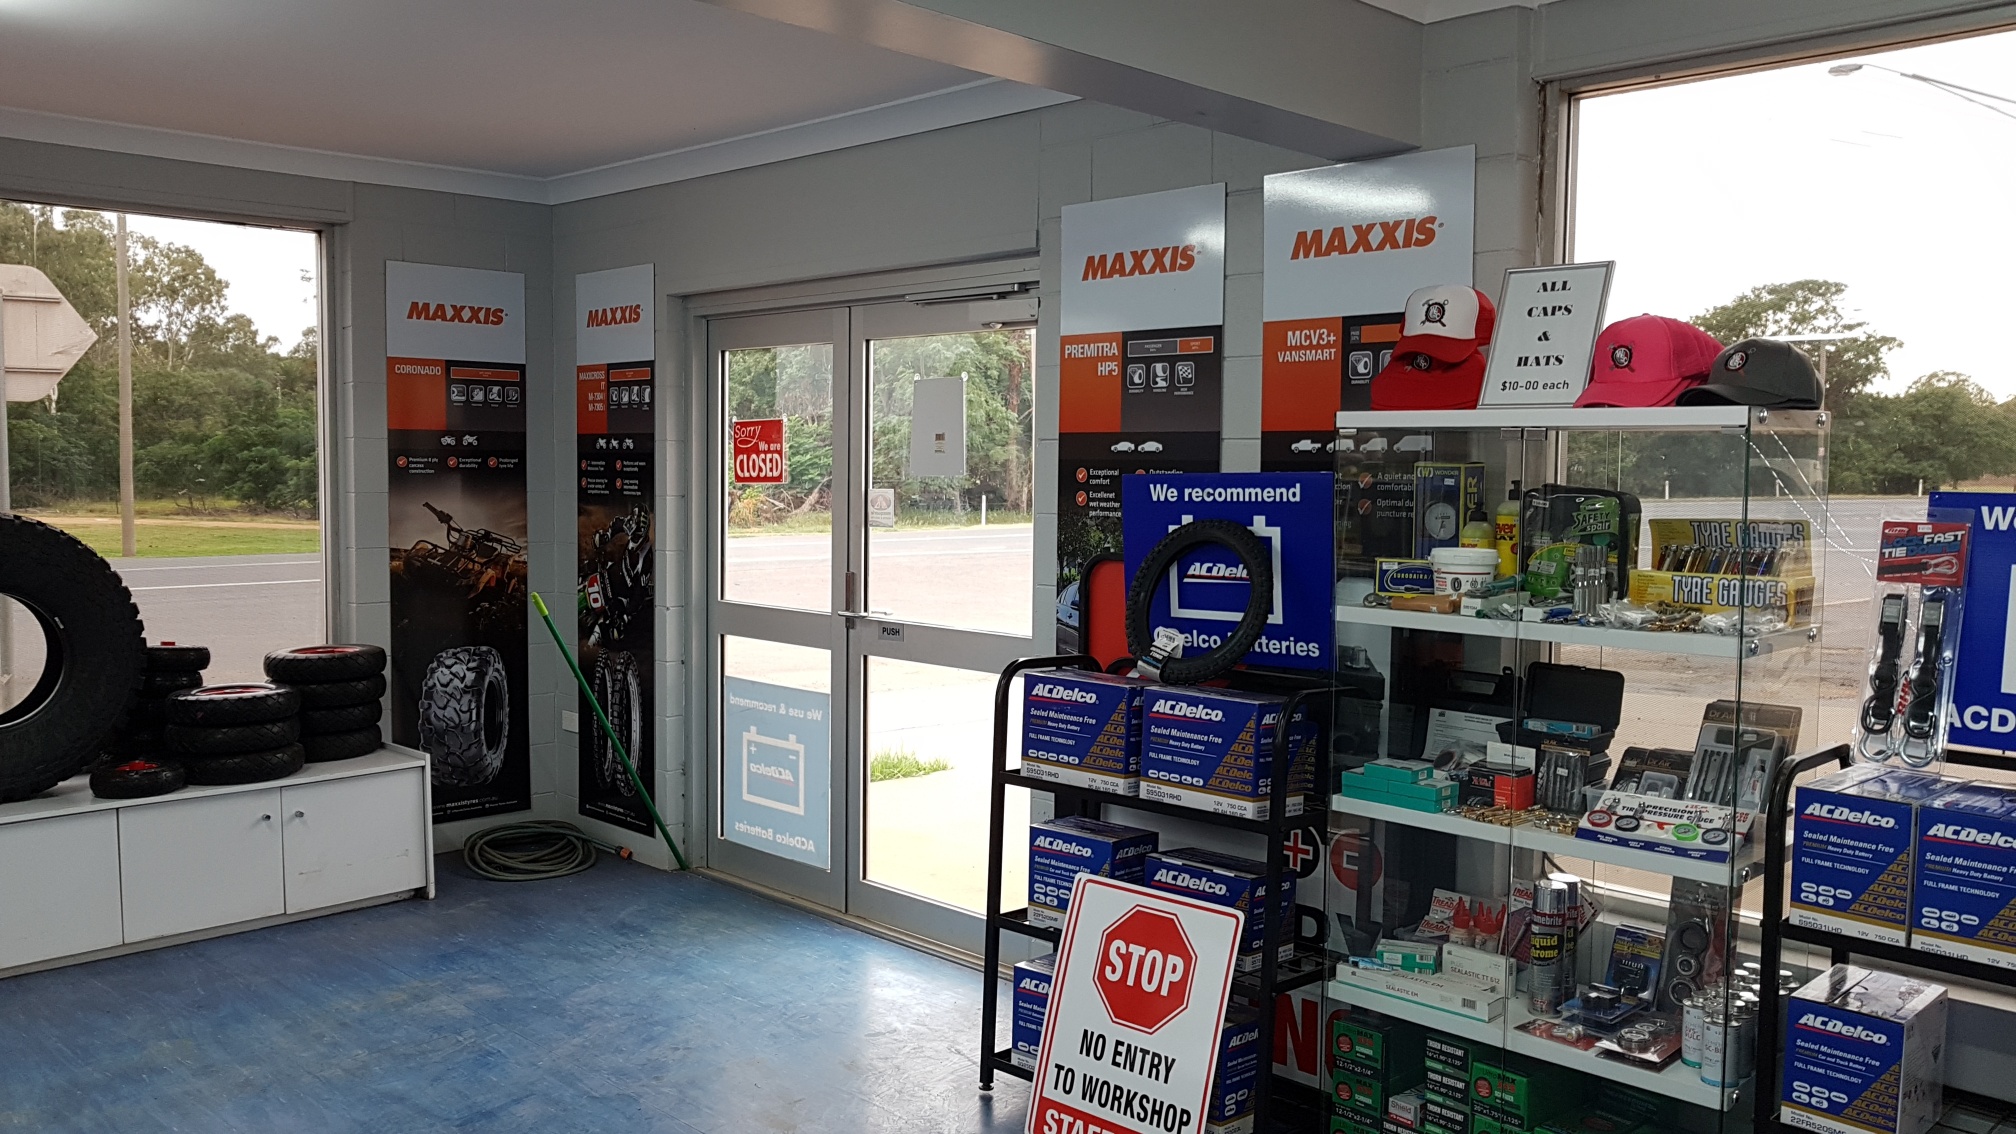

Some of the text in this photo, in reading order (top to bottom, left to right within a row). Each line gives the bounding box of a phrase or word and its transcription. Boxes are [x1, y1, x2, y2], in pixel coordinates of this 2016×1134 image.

[1290, 216, 1438, 260] MAXXIS
[1082, 244, 1196, 281] MAXXIS
[1537, 280, 1572, 293] ALL
[407, 302, 504, 326] MAXXIS
[586, 304, 641, 328] MAXXIS
[1527, 304, 1573, 318] CAPS
[1287, 328, 1336, 348] MCV3+
[1537, 330, 1552, 342] &
[1064, 342, 1118, 358] PREMITRA
[1278, 348, 1336, 362] VANSMART
[395, 364, 442, 376] CORONADO
[1097, 362, 1118, 376] HP5
[1516, 355, 1564, 368] HATS
[1500, 380, 1569, 392] $10-00 each
[734, 424, 761, 448] Sorry
[758, 441, 781, 451] We are
[736, 454, 781, 478] CLOSED
[1384, 473, 1401, 481] quiet
[1150, 483, 1300, 502] We recommend
[1573, 512, 1610, 530] SAFETY
[1690, 521, 1731, 547] TYRE
[1672, 575, 1713, 605] TYRE
[882, 627, 900, 636] PUSH
[1031, 683, 1096, 704] ACDelco
[1030, 708, 1096, 724] Sealed Maintenance Free
[1152, 699, 1223, 722] ACDelco
[1051, 736, 1075, 746] TECHNOLOGY
[1150, 725, 1222, 744] Sealed Maintenance Free
[1159, 753, 1173, 761] FRAME
[1173, 756, 1200, 766] TECHNOLOGY
[1644, 810, 1684, 820] PRESSURE
[1687, 815, 1715, 823] GUGE
[1646, 805, 1693, 814] PRECISION
[1804, 803, 1895, 828] ACDelco
[1034, 836, 1092, 857] ACDelco
[1803, 831, 1894, 853] Sealed Maintenance Free
[1116, 844, 1152, 859] ACDelco
[1855, 850, 1872, 858] Battery
[1035, 856, 1079, 871] Sealed Maintenance
[1815, 859, 1832, 868] FRAME
[1834, 862, 1869, 874] TECHNOLOGY
[1926, 852, 2007, 872] Sealed Maintenance
[1153, 868, 1227, 896] ACDelco
[1952, 868, 1969, 876] Heavy
[1983, 873, 2003, 882] Battery
[1938, 883, 1958, 892] FRAME
[1960, 886, 2000, 899] TECHNOLOGY
[1104, 939, 1184, 996] STOP
[1450, 966, 1480, 979] SEALASTIC
[1385, 984, 1410, 996] SEALASTIC
[1798, 1013, 1887, 1044] ACDelco
[1080, 1029, 1176, 1085] NO ENTRY
[1427, 1039, 1464, 1057] THORN RESISTANT
[1796, 1039, 1880, 1066] Sealed Maintenance Free
[1427, 1071, 1465, 1090] THORN RESISTANT
[1807, 1065, 1826, 1074] FRAME
[1827, 1070, 1862, 1084] TECHNOLOGY
[1053, 1063, 1191, 1134] TO WORKSHOP
[1391, 1101, 1412, 1113] Shield
[1427, 1103, 1464, 1122] THORN RESISTANT
